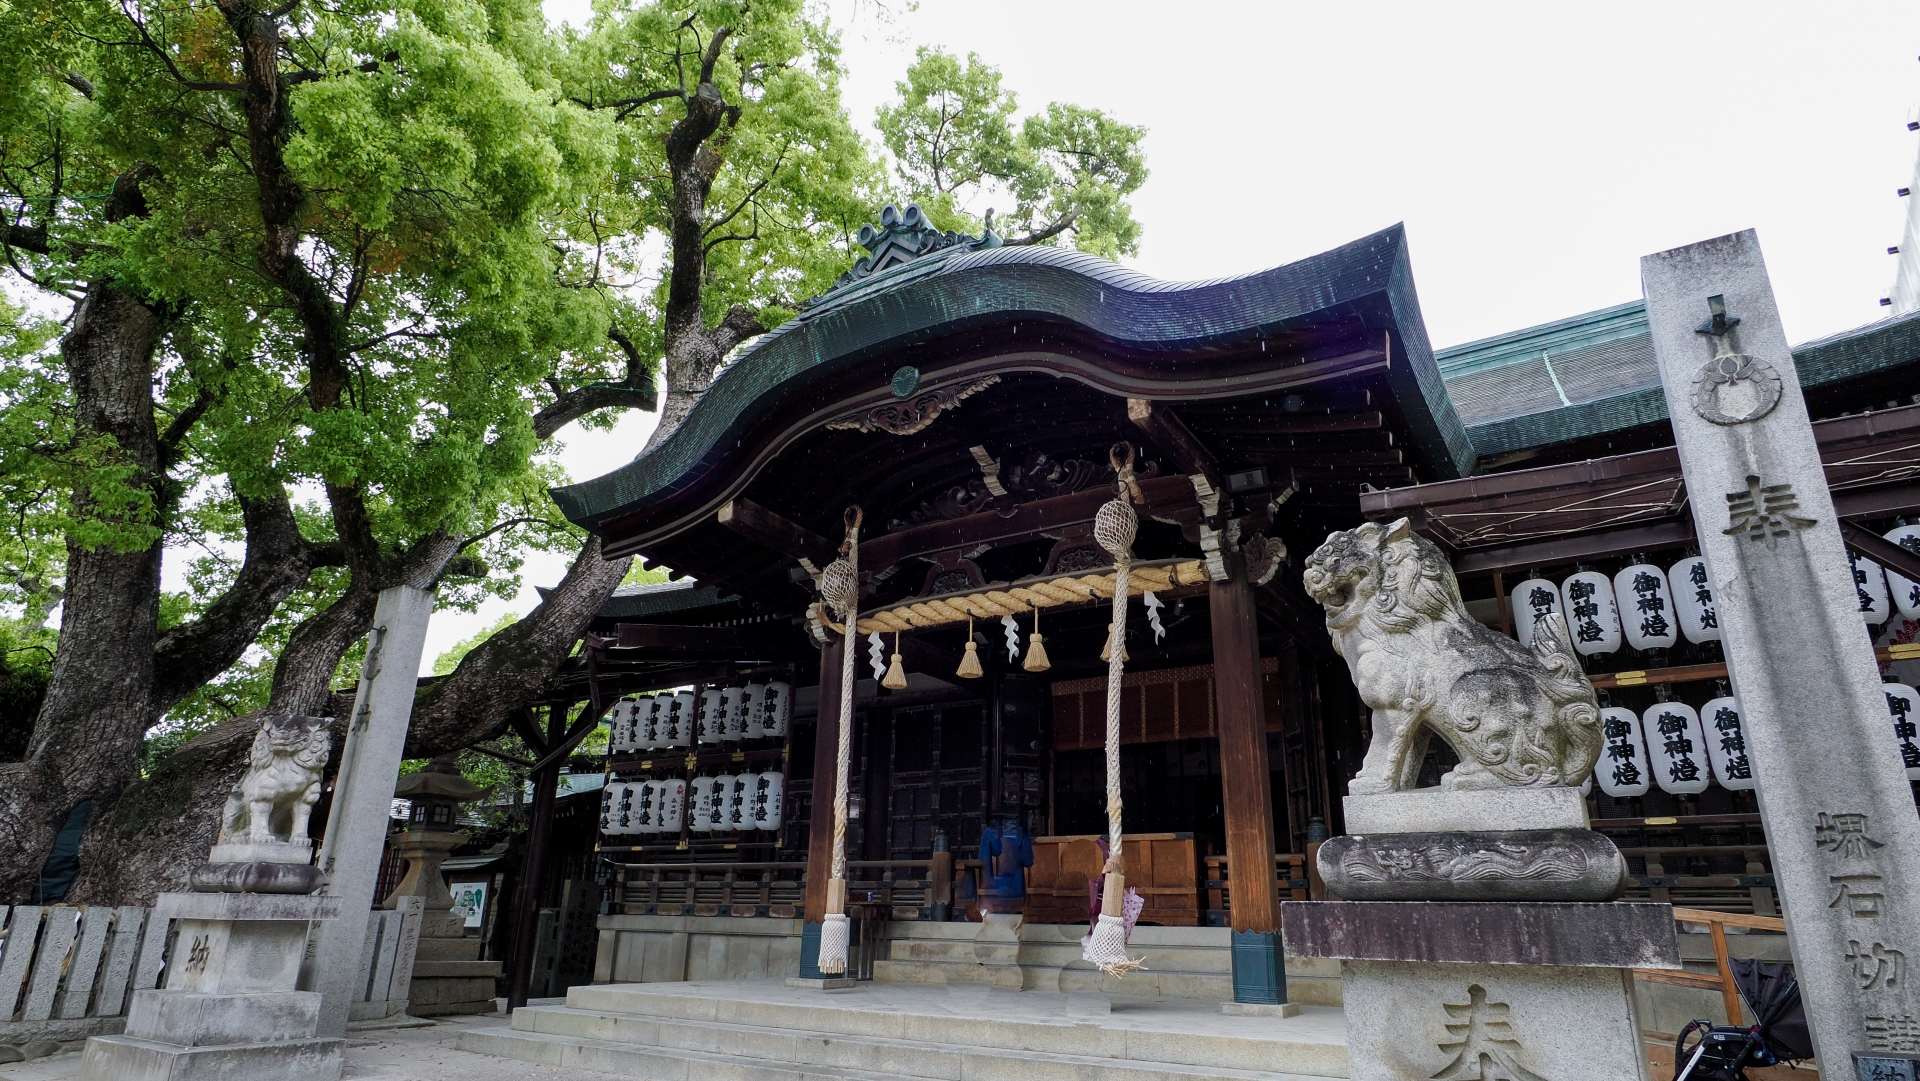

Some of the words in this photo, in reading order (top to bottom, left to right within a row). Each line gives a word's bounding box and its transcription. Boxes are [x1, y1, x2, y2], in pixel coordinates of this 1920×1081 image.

[1722, 475, 1817, 550] 奉
[1568, 579, 1604, 645] 御神燈
[1632, 571, 1669, 638] 御神燈
[1603, 715, 1641, 787] 御神燈
[1657, 711, 1700, 783] 御神燈
